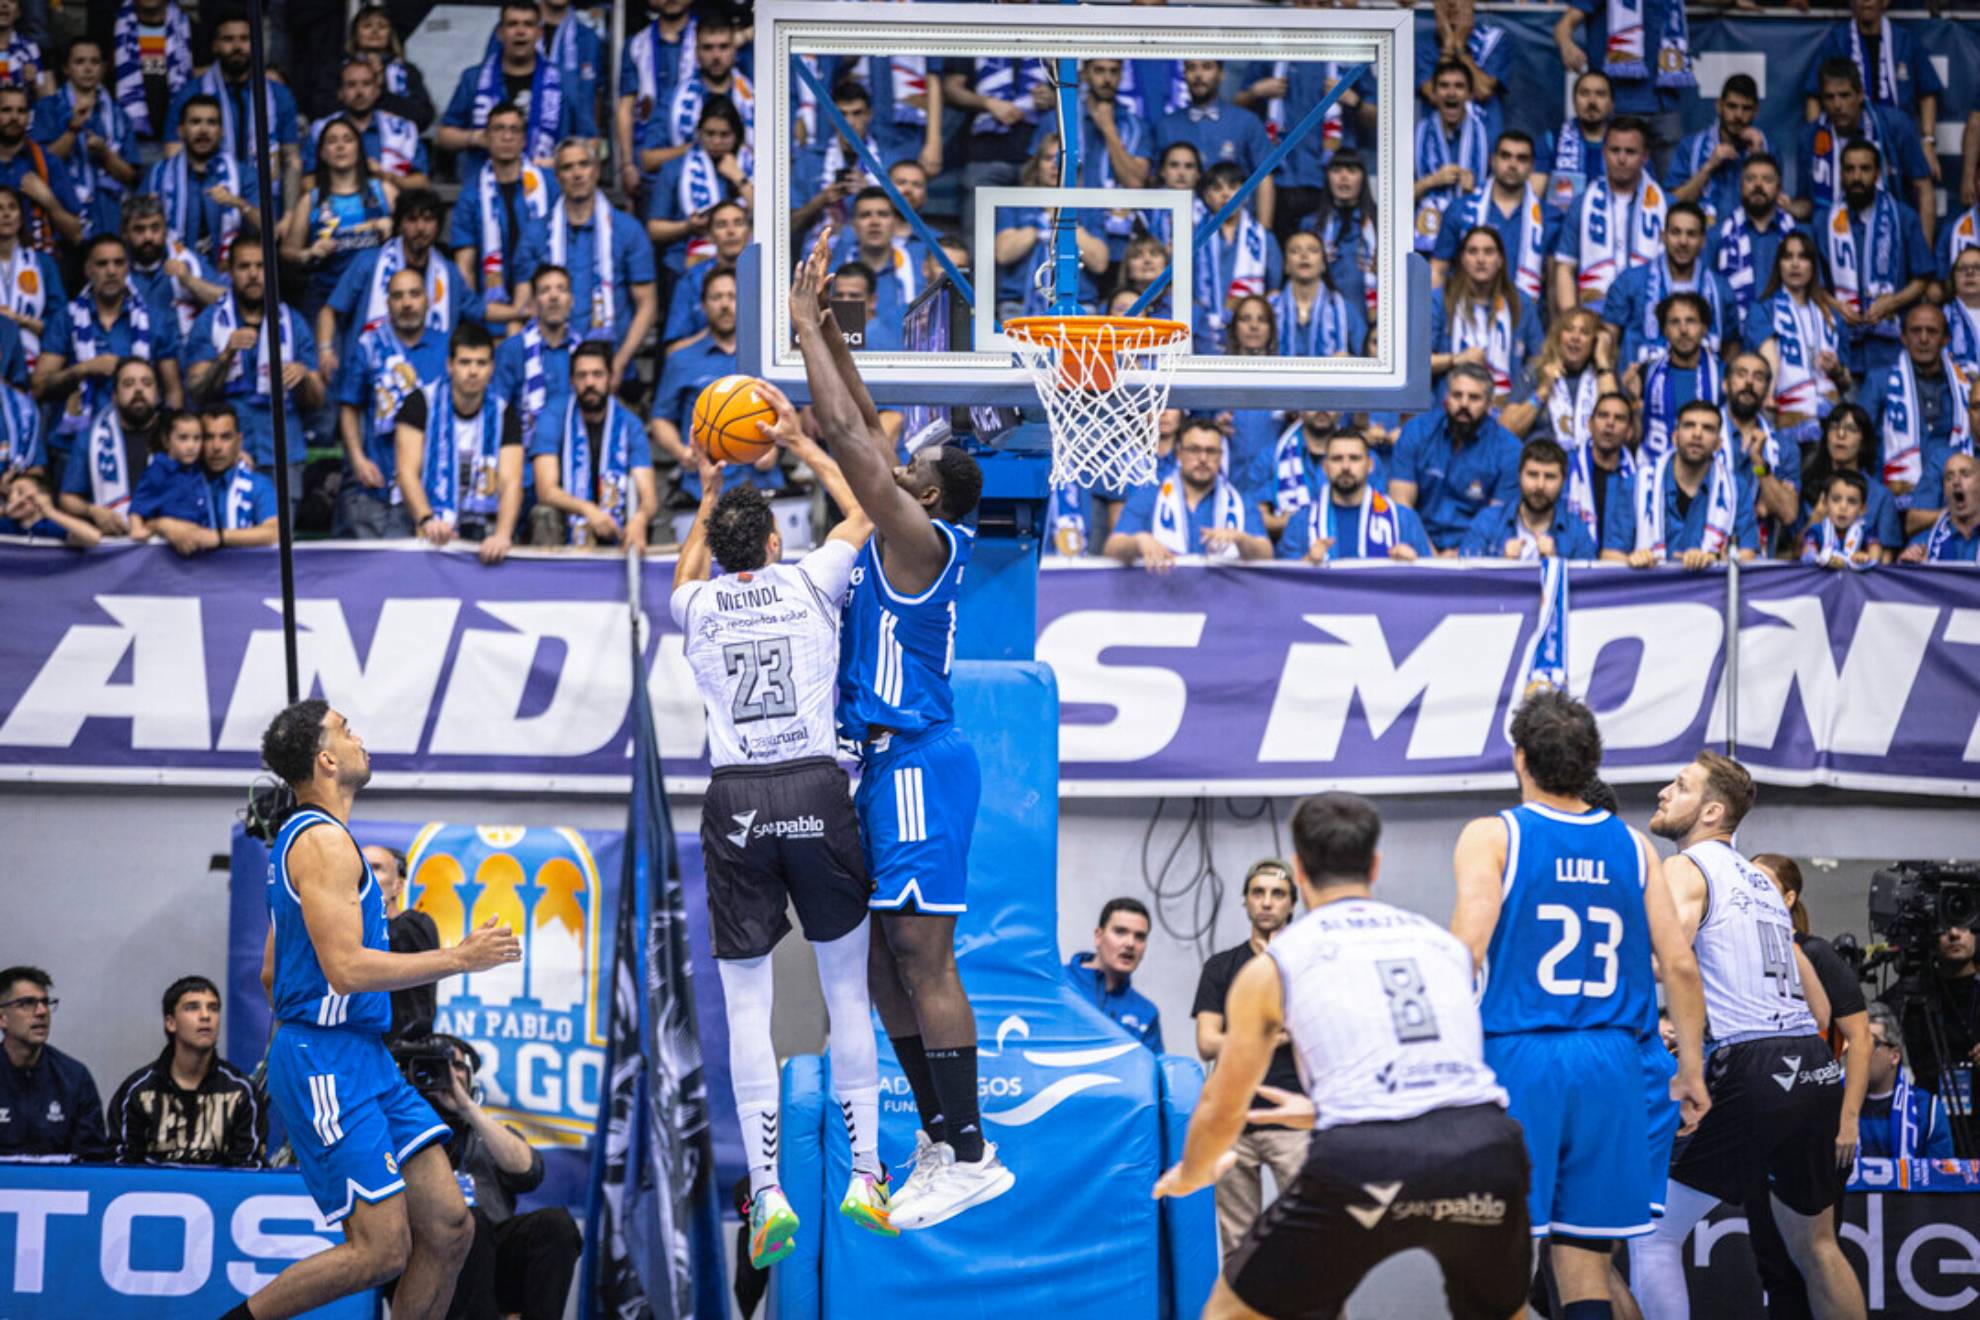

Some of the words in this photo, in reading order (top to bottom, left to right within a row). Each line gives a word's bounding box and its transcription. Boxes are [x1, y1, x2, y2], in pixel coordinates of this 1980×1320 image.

[716, 585, 783, 612] MEINDL
[722, 637, 797, 724] 23
[1556, 857, 1610, 884] LLULL
[1537, 904, 1623, 998] 23
[1374, 957, 1440, 1044] 8
[433, 1010, 476, 1036] AN
[486, 1010, 573, 1043] PABLO
[884, 1100, 918, 1113] FUN
